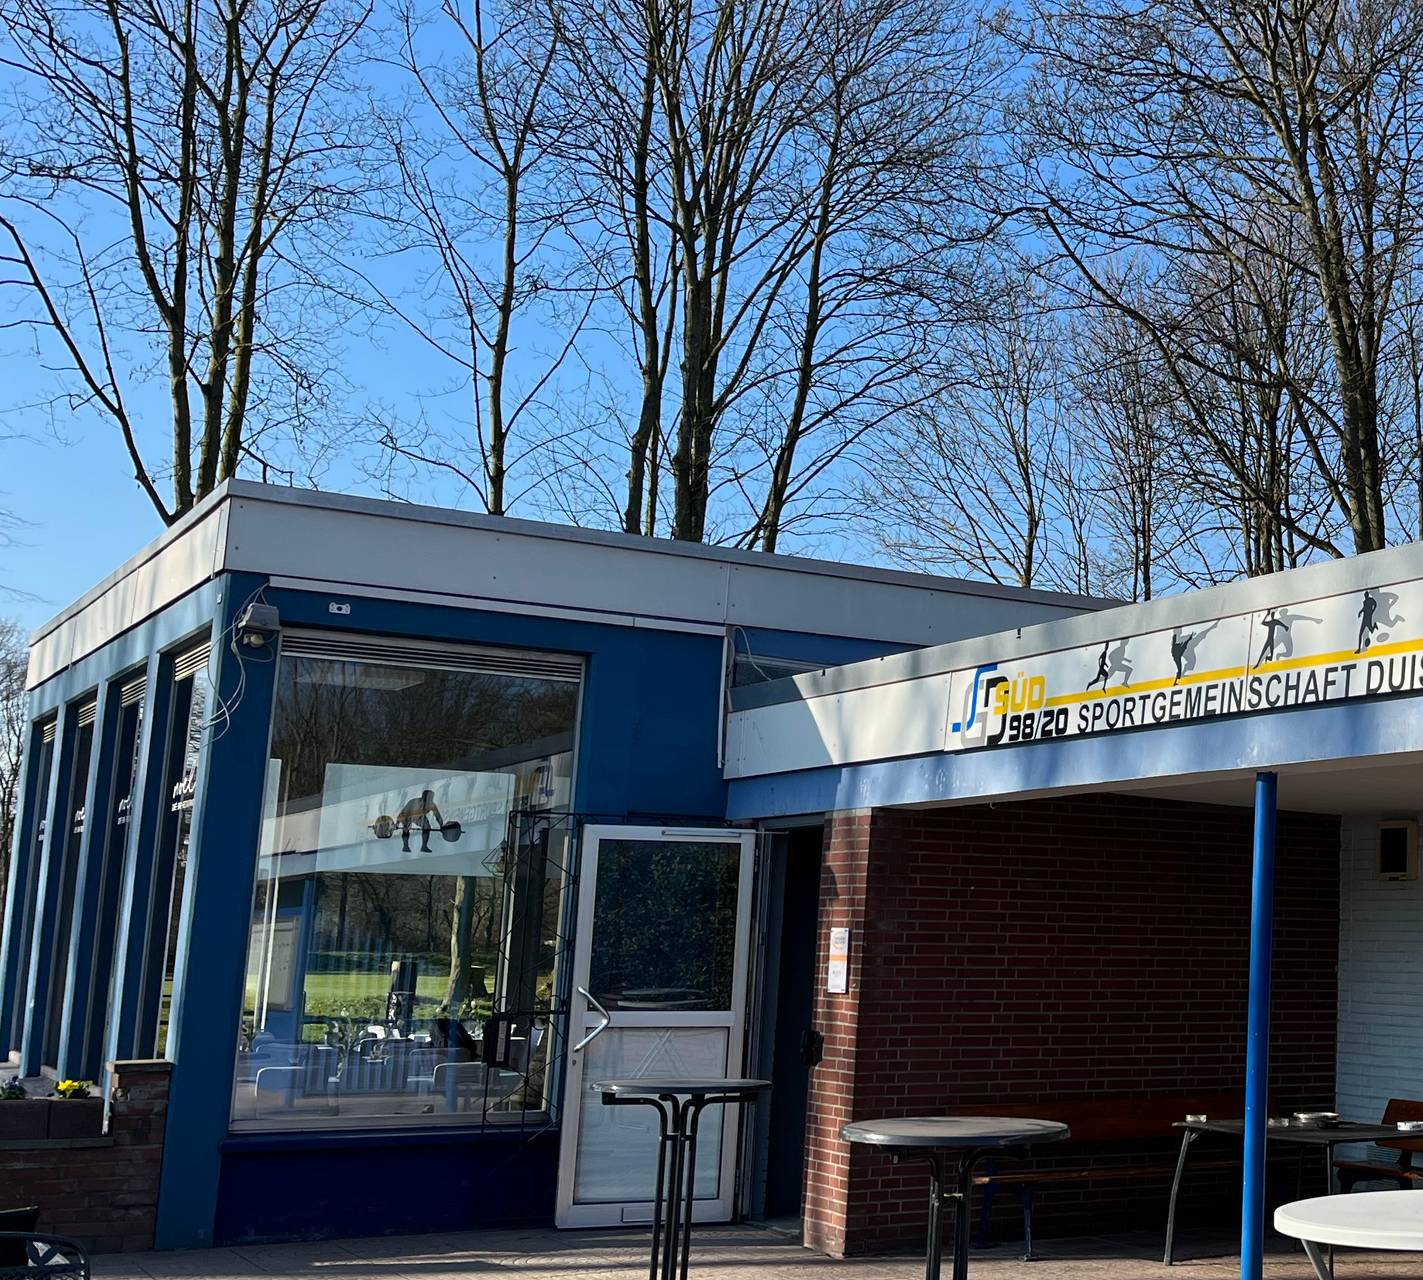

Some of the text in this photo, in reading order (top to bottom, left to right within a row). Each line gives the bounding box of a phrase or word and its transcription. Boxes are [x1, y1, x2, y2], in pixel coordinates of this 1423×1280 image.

[994, 672, 1045, 715] SÜD
[1078, 664, 1355, 733] SPORTGEMEINSCHAFT
[1009, 708, 1068, 741] 98/20
